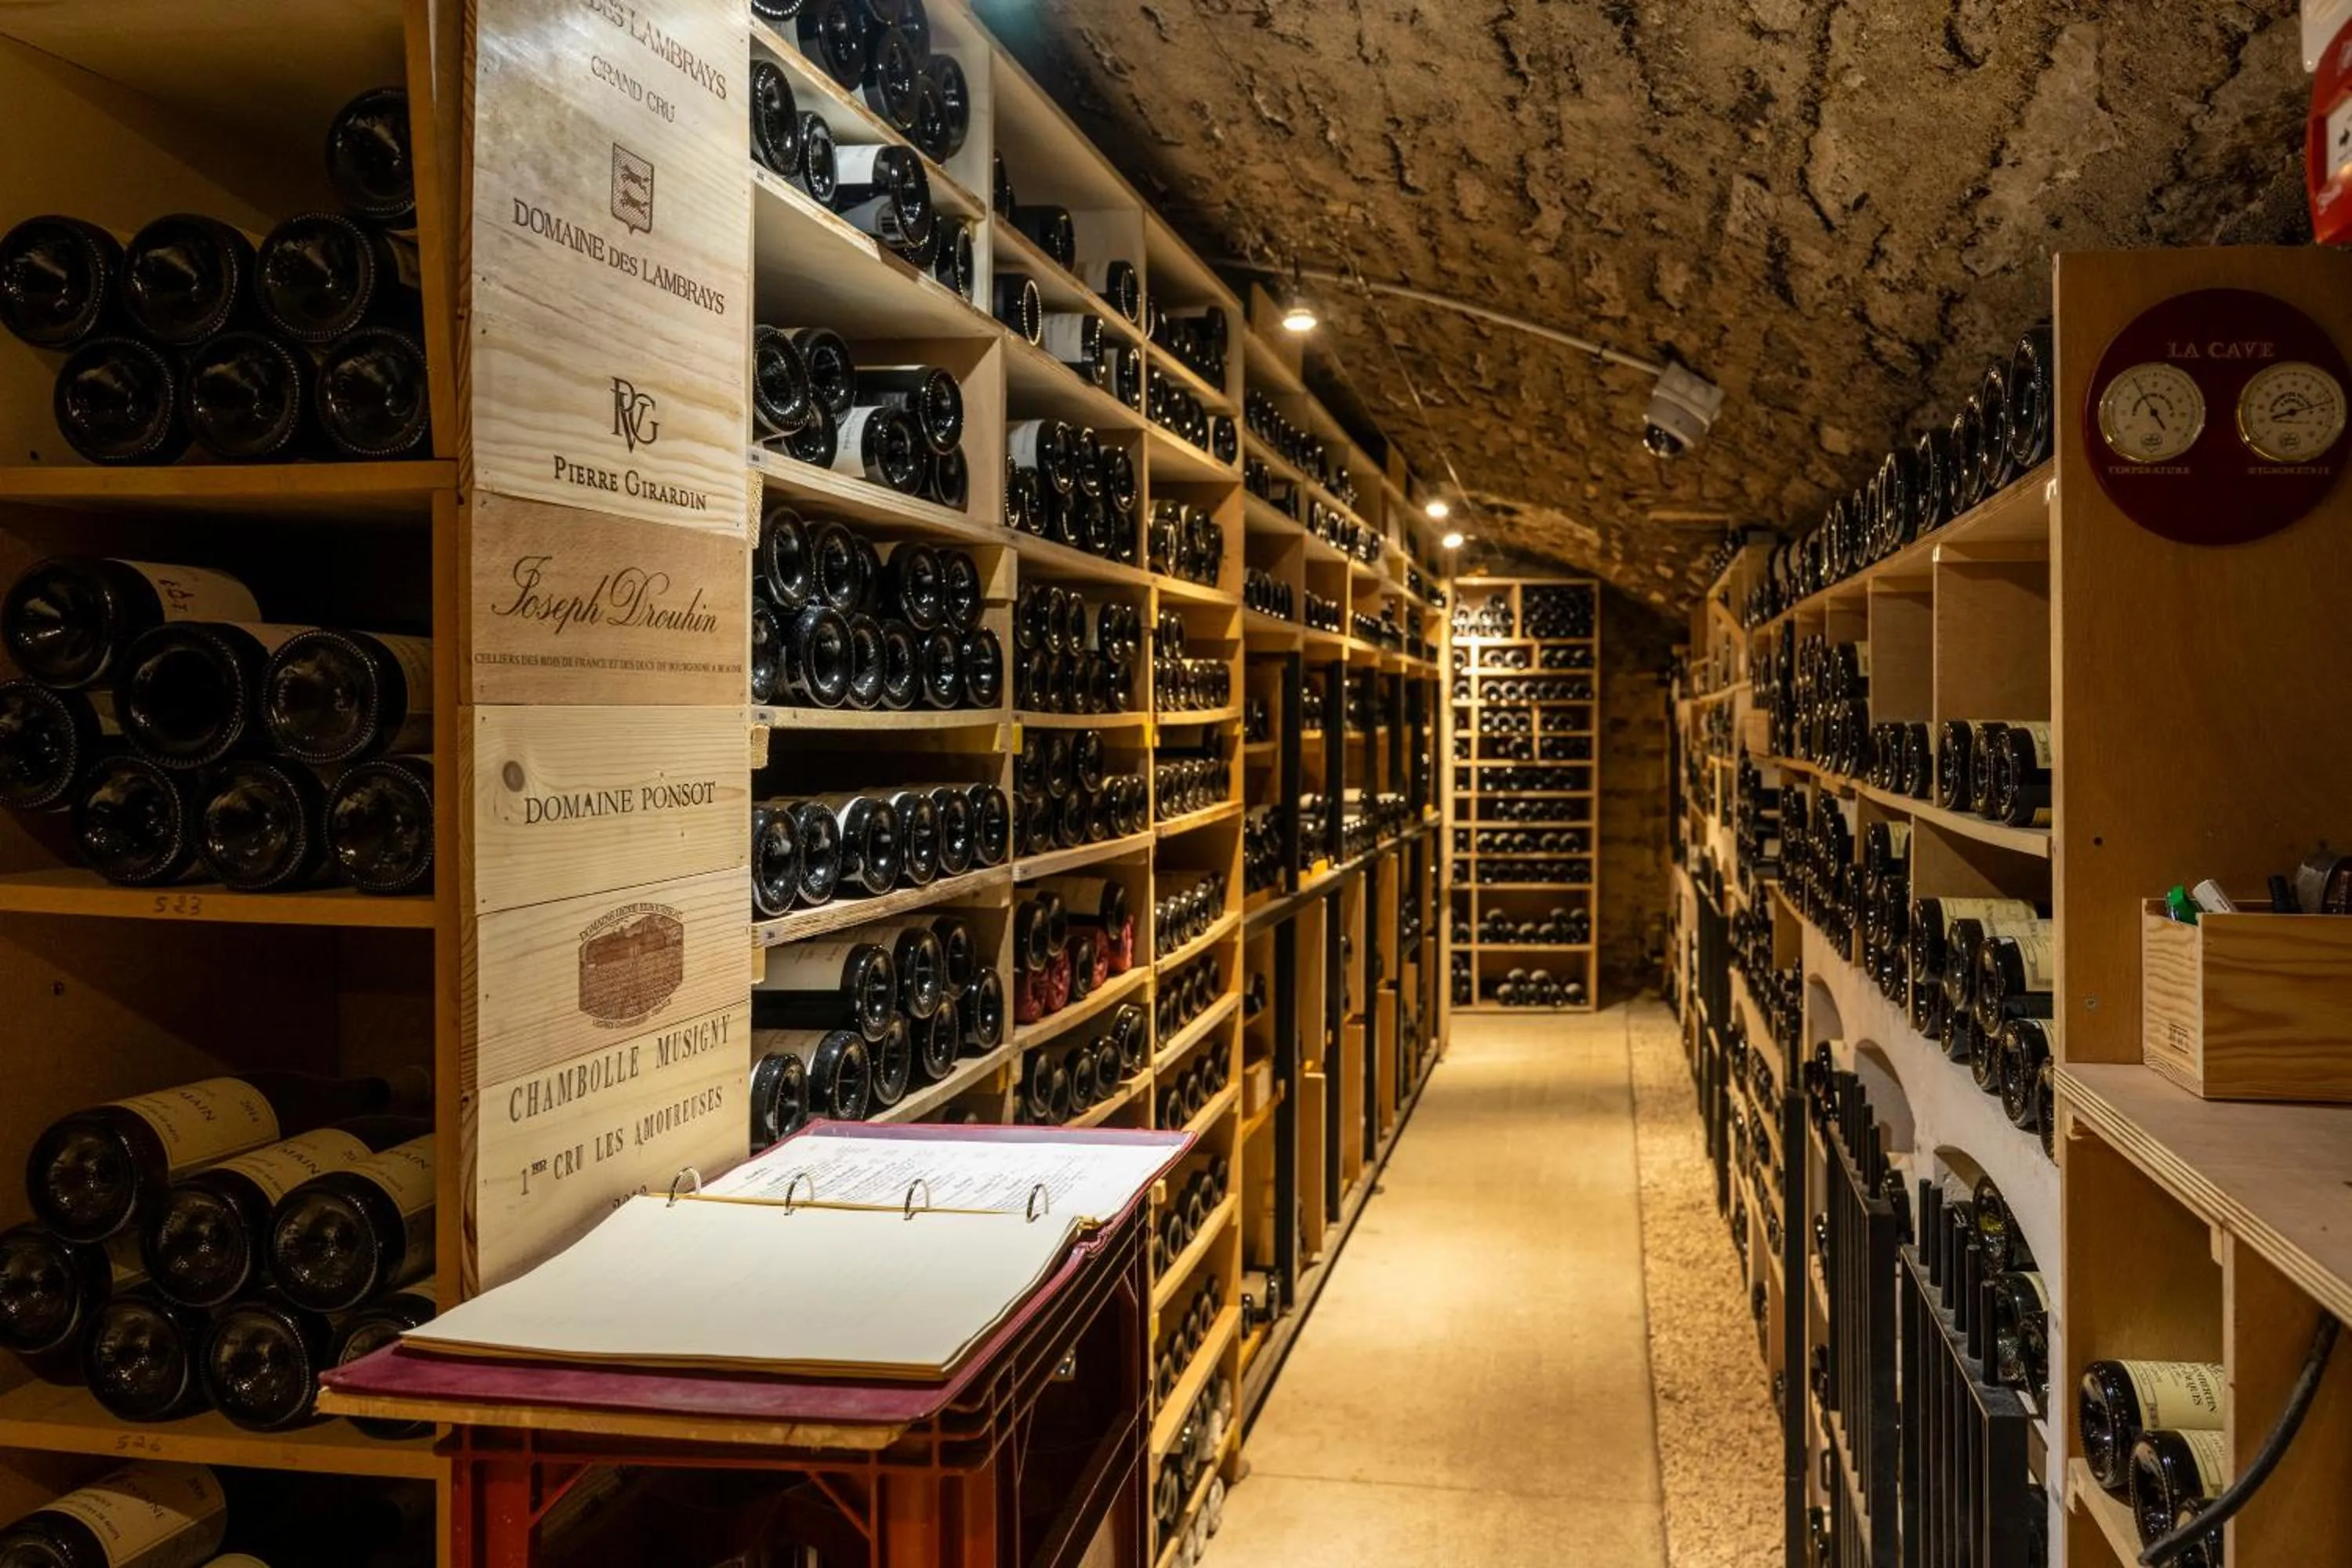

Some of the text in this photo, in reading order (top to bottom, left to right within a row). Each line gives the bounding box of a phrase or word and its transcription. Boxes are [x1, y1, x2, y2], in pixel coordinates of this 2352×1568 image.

[590, 55, 676, 123] GRAND CRU
[630, 11, 727, 100] LAMBRAYS
[513, 198, 725, 314] DOMAINE DES LAMBRAYS
[2167, 341, 2275, 359] LA CAVE
[553, 455, 706, 511] PIERRE GIRARDIN
[491, 555, 718, 635] Joseph Drouhin
[525, 780, 716, 825] DOMAINE PONSOT
[510, 1014, 731, 1123] CHAMBOLLE MUSIGNY
[554, 1144, 584, 1181] CRU
[595, 1126, 624, 1162] LES
[634, 1085, 724, 1145] AMOUREUSES
